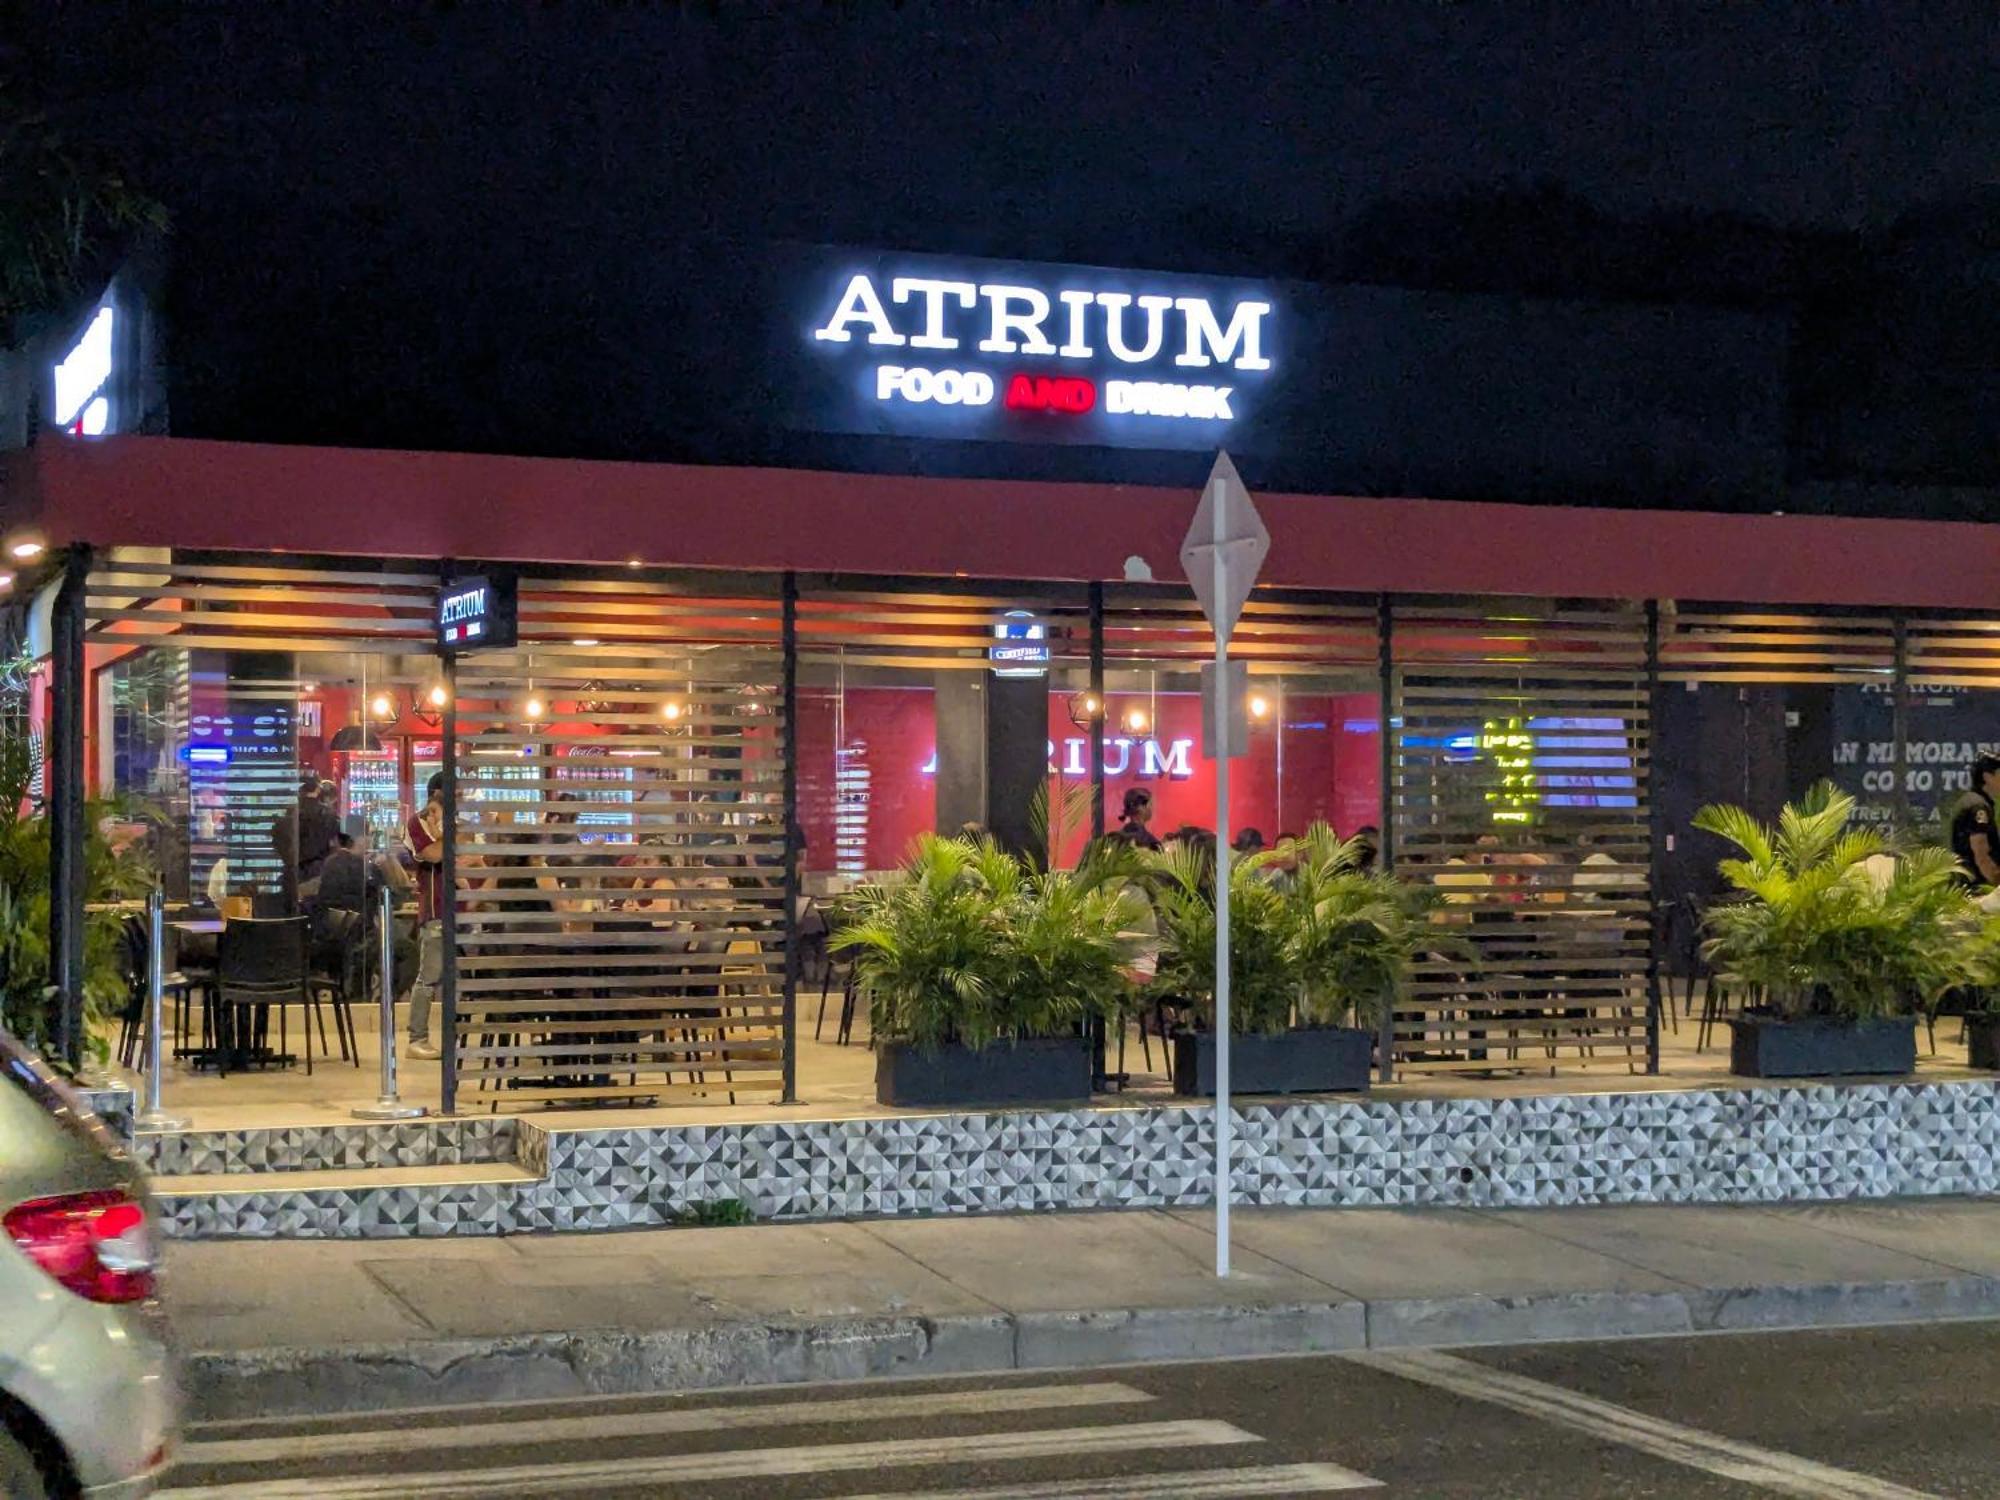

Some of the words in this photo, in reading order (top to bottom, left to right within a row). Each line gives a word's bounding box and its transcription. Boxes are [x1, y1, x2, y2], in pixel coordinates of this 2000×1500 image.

[814, 275, 1271, 370] ATRIUM
[876, 365, 994, 405] FOOD
[1005, 374, 1097, 414] AND
[1105, 380, 1234, 419] DRINK
[441, 588, 485, 624] ATRIUM
